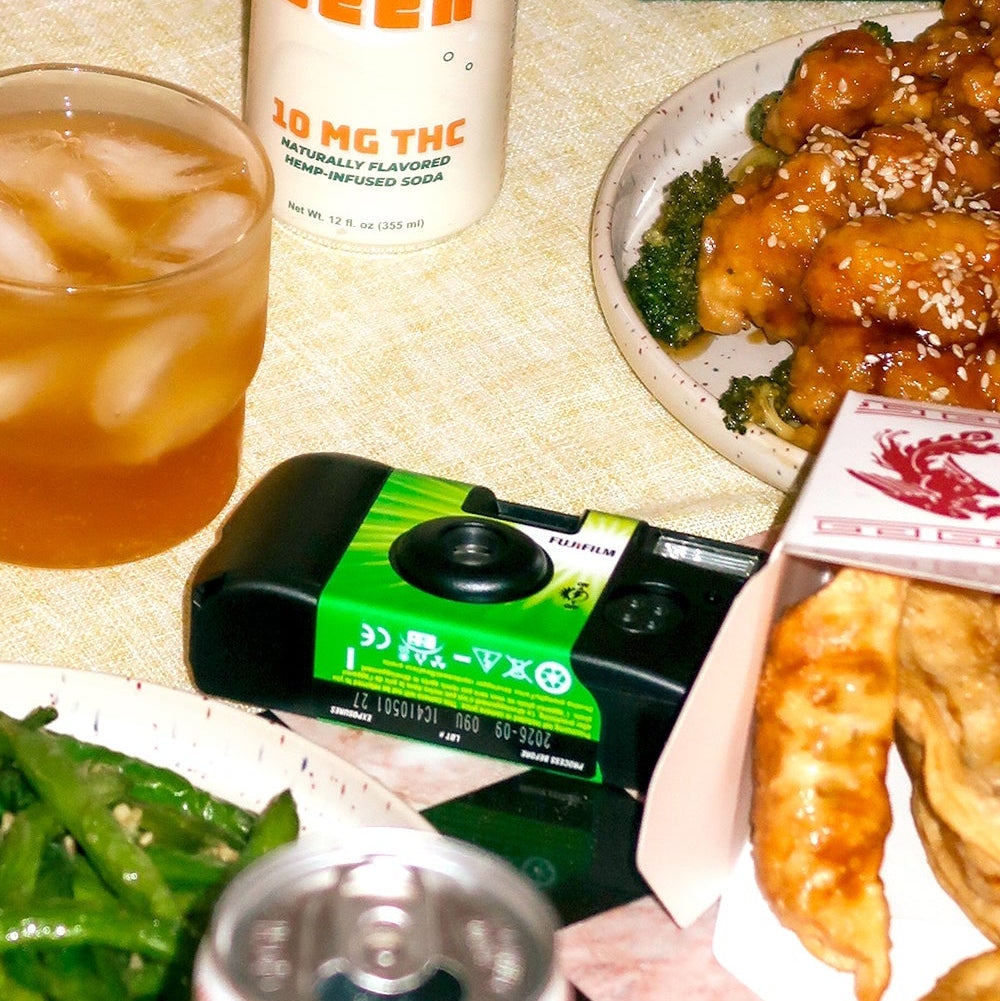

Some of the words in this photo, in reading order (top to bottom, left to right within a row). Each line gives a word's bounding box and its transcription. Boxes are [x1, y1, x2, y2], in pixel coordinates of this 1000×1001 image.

[272, 96, 311, 139] 10
[320, 119, 379, 155] MG
[391, 117, 467, 155] THC
[280, 136, 366, 170] NATURALLY
[368, 155, 451, 173] FLAVORED
[284, 153, 397, 187] HEMP-INFUSED
[400, 171, 444, 187] SODA
[288, 200, 305, 216] Net
[306, 207, 325, 222] Wt.
[328, 215, 342, 226] 12
[345, 217, 357, 228] fl.
[360, 221, 375, 230] oz
[378, 219, 403, 231] (355
[406, 218, 425, 230] ml)
[548, 535, 616, 558] FUJIFILM
[330, 695, 373, 722] EXPOSURES
[353, 691, 369, 710] 27
[456, 712, 480, 734] 09U
[495, 721, 551, 749] 2026-09
[445, 732, 461, 743] LOT
[520, 748, 550, 763] BEFORE
[550, 755, 584, 771] PROCESS
